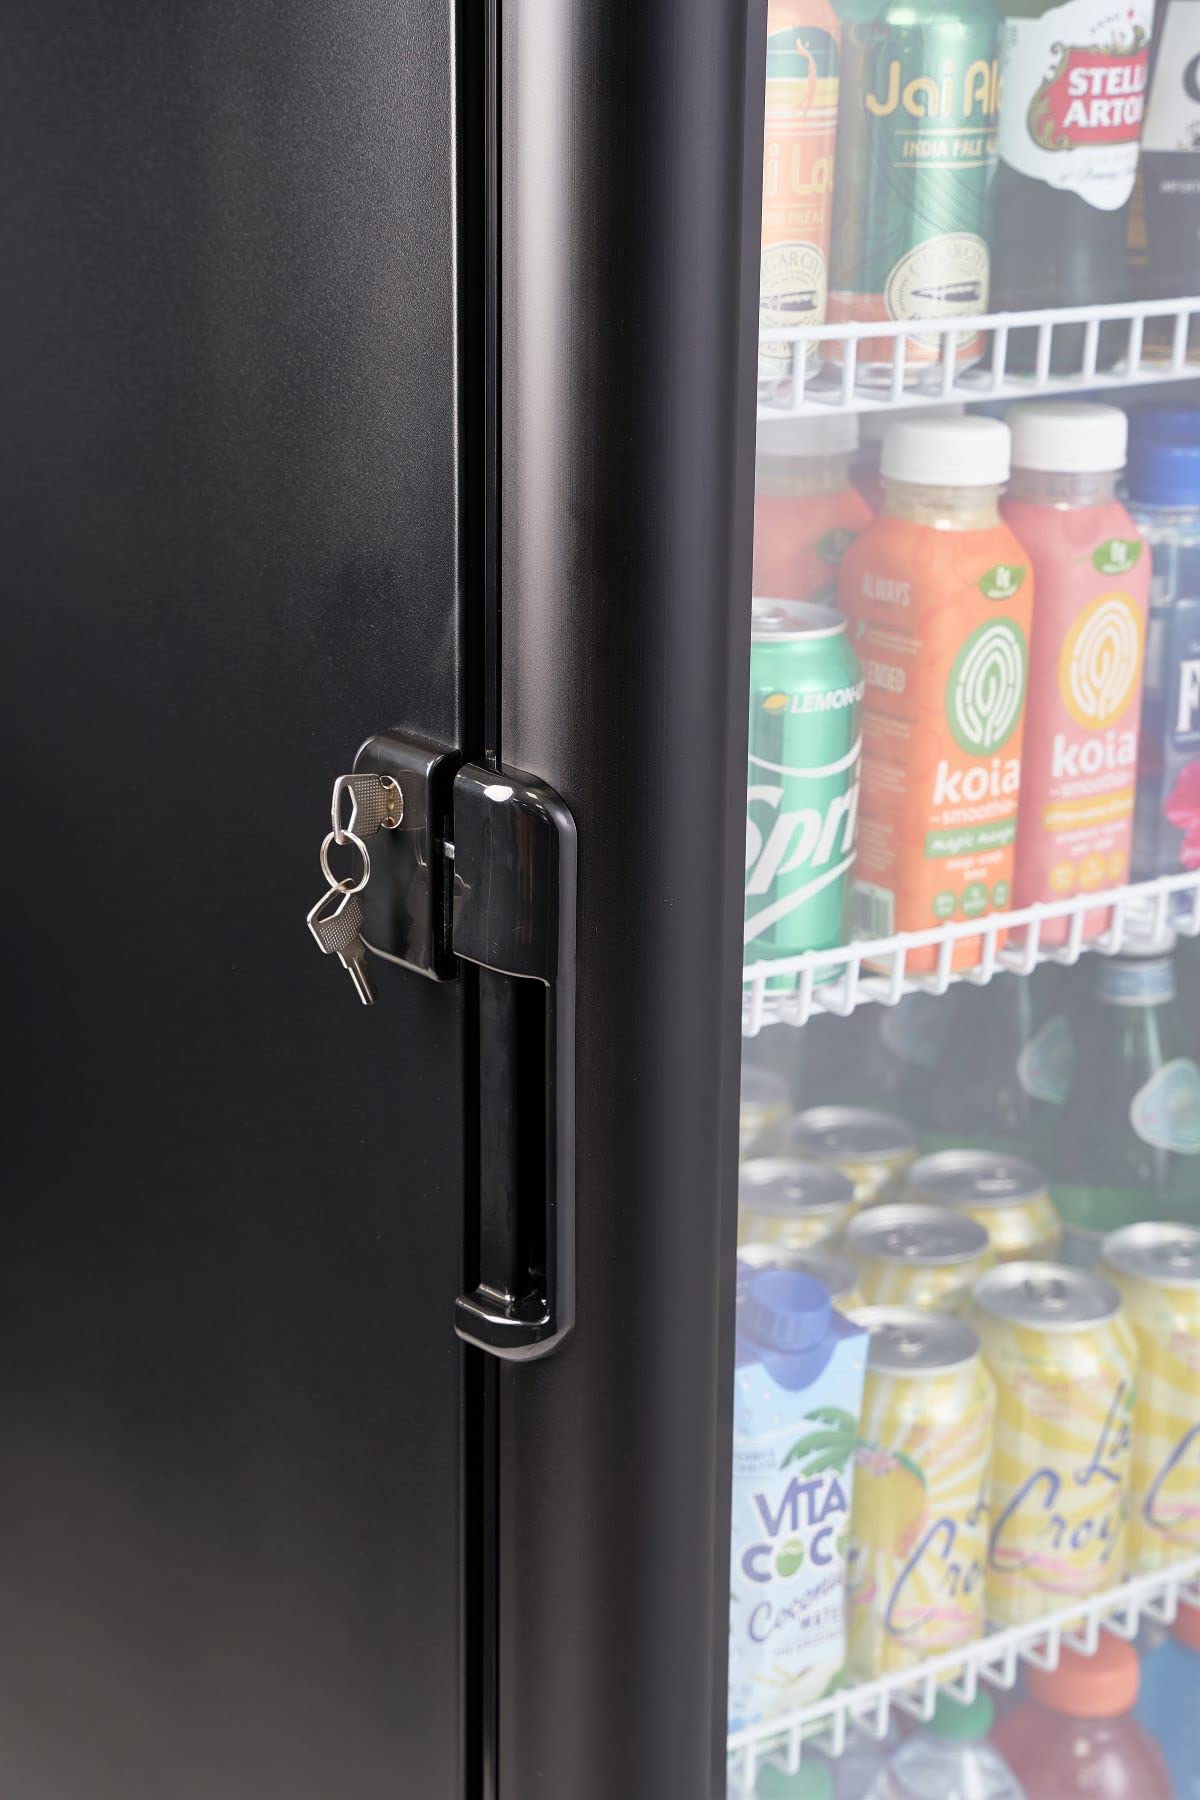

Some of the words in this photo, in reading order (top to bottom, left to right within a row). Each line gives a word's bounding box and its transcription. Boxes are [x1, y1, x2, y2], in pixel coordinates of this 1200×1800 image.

[866, 60, 953, 117] Jai
[1067, 64, 1148, 96] STELL
[1062, 93, 1144, 128] ARTO
[1052, 730, 1137, 778] koia
[932, 757, 1020, 805] koia
[754, 1475, 847, 1537] VITA
